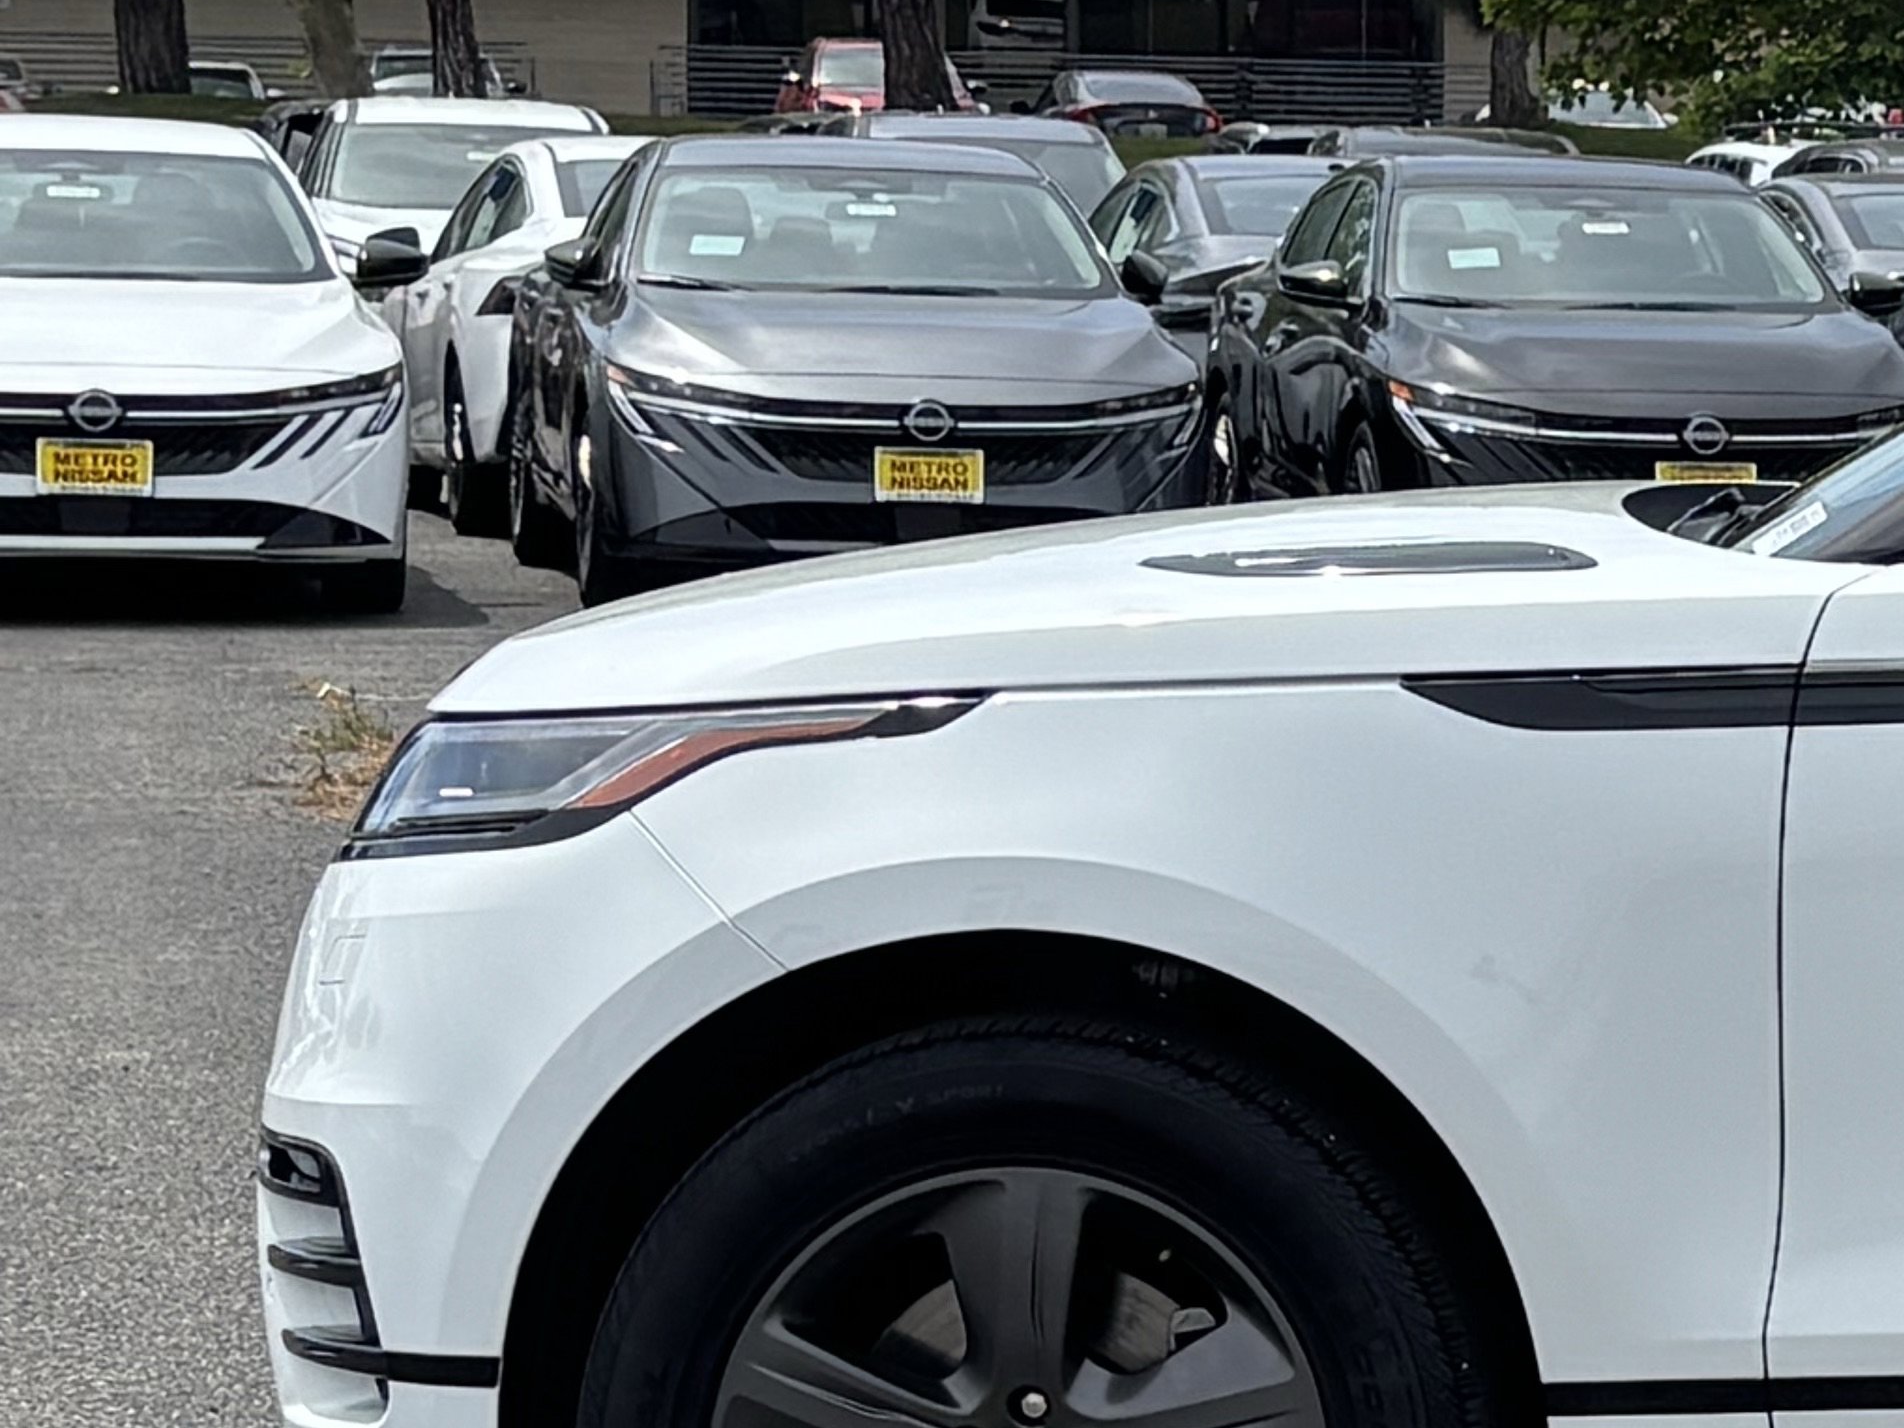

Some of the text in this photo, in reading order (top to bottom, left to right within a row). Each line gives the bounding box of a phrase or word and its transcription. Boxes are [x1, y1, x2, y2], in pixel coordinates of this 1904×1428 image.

[53, 451, 137, 468] METRO
[890, 459, 969, 476] METRO
[54, 469, 138, 483] NISSAN
[890, 476, 969, 491] NISSAN
